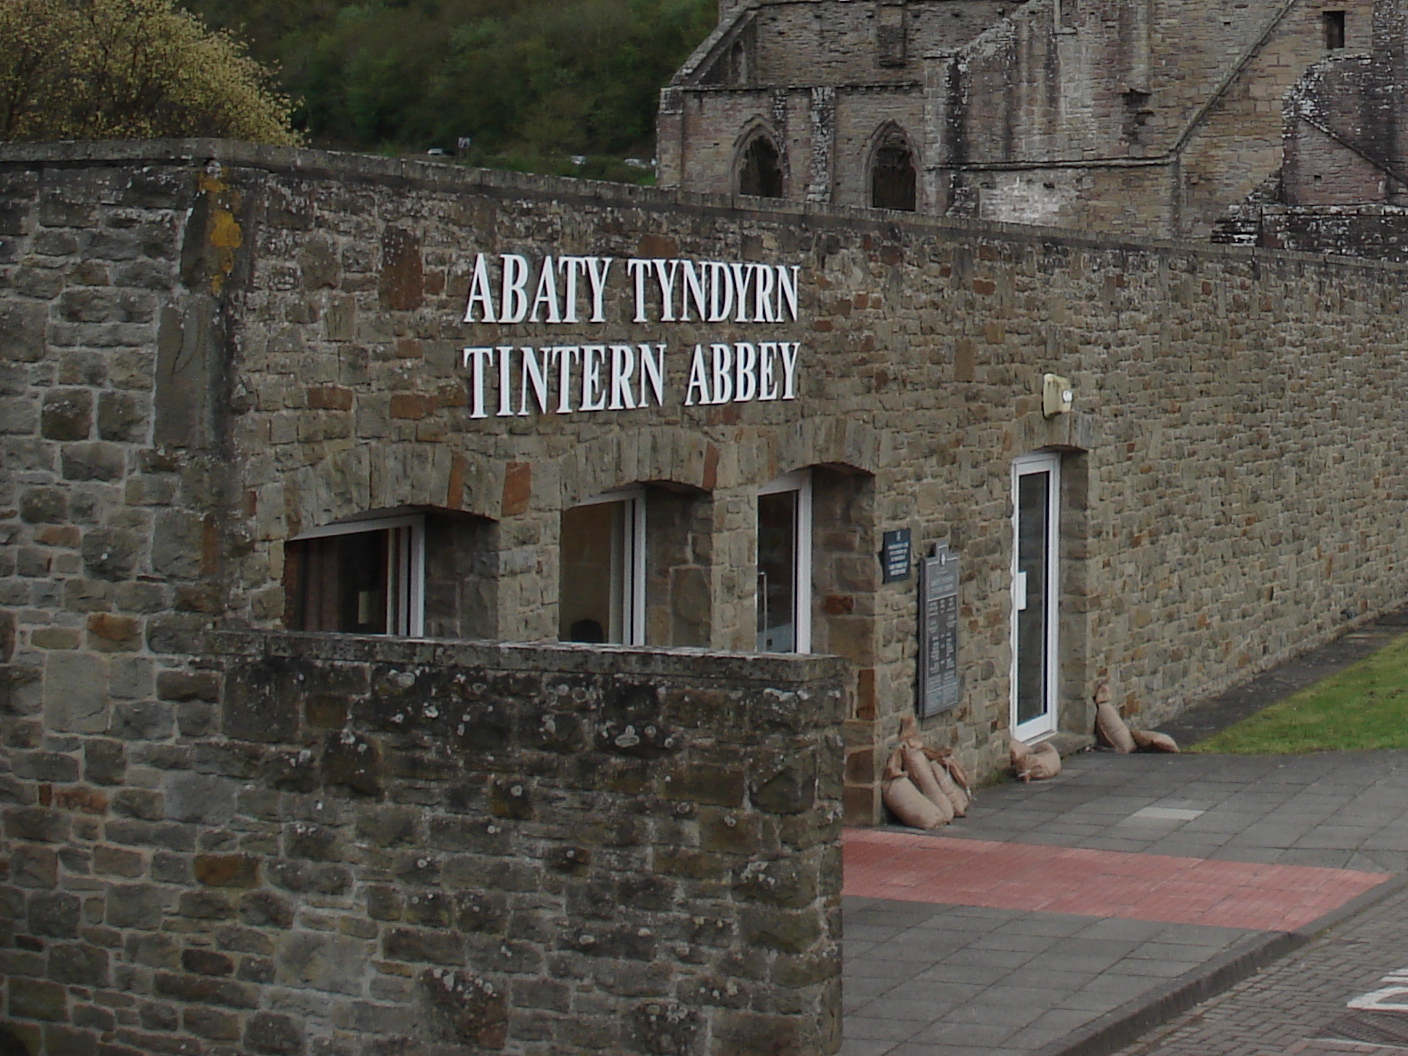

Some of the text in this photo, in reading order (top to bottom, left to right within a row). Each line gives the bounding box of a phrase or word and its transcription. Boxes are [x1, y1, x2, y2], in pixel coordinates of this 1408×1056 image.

[463, 253, 800, 323] ABATY TYNDYRN
[463, 342, 801, 418] TINTERN ABBEY
